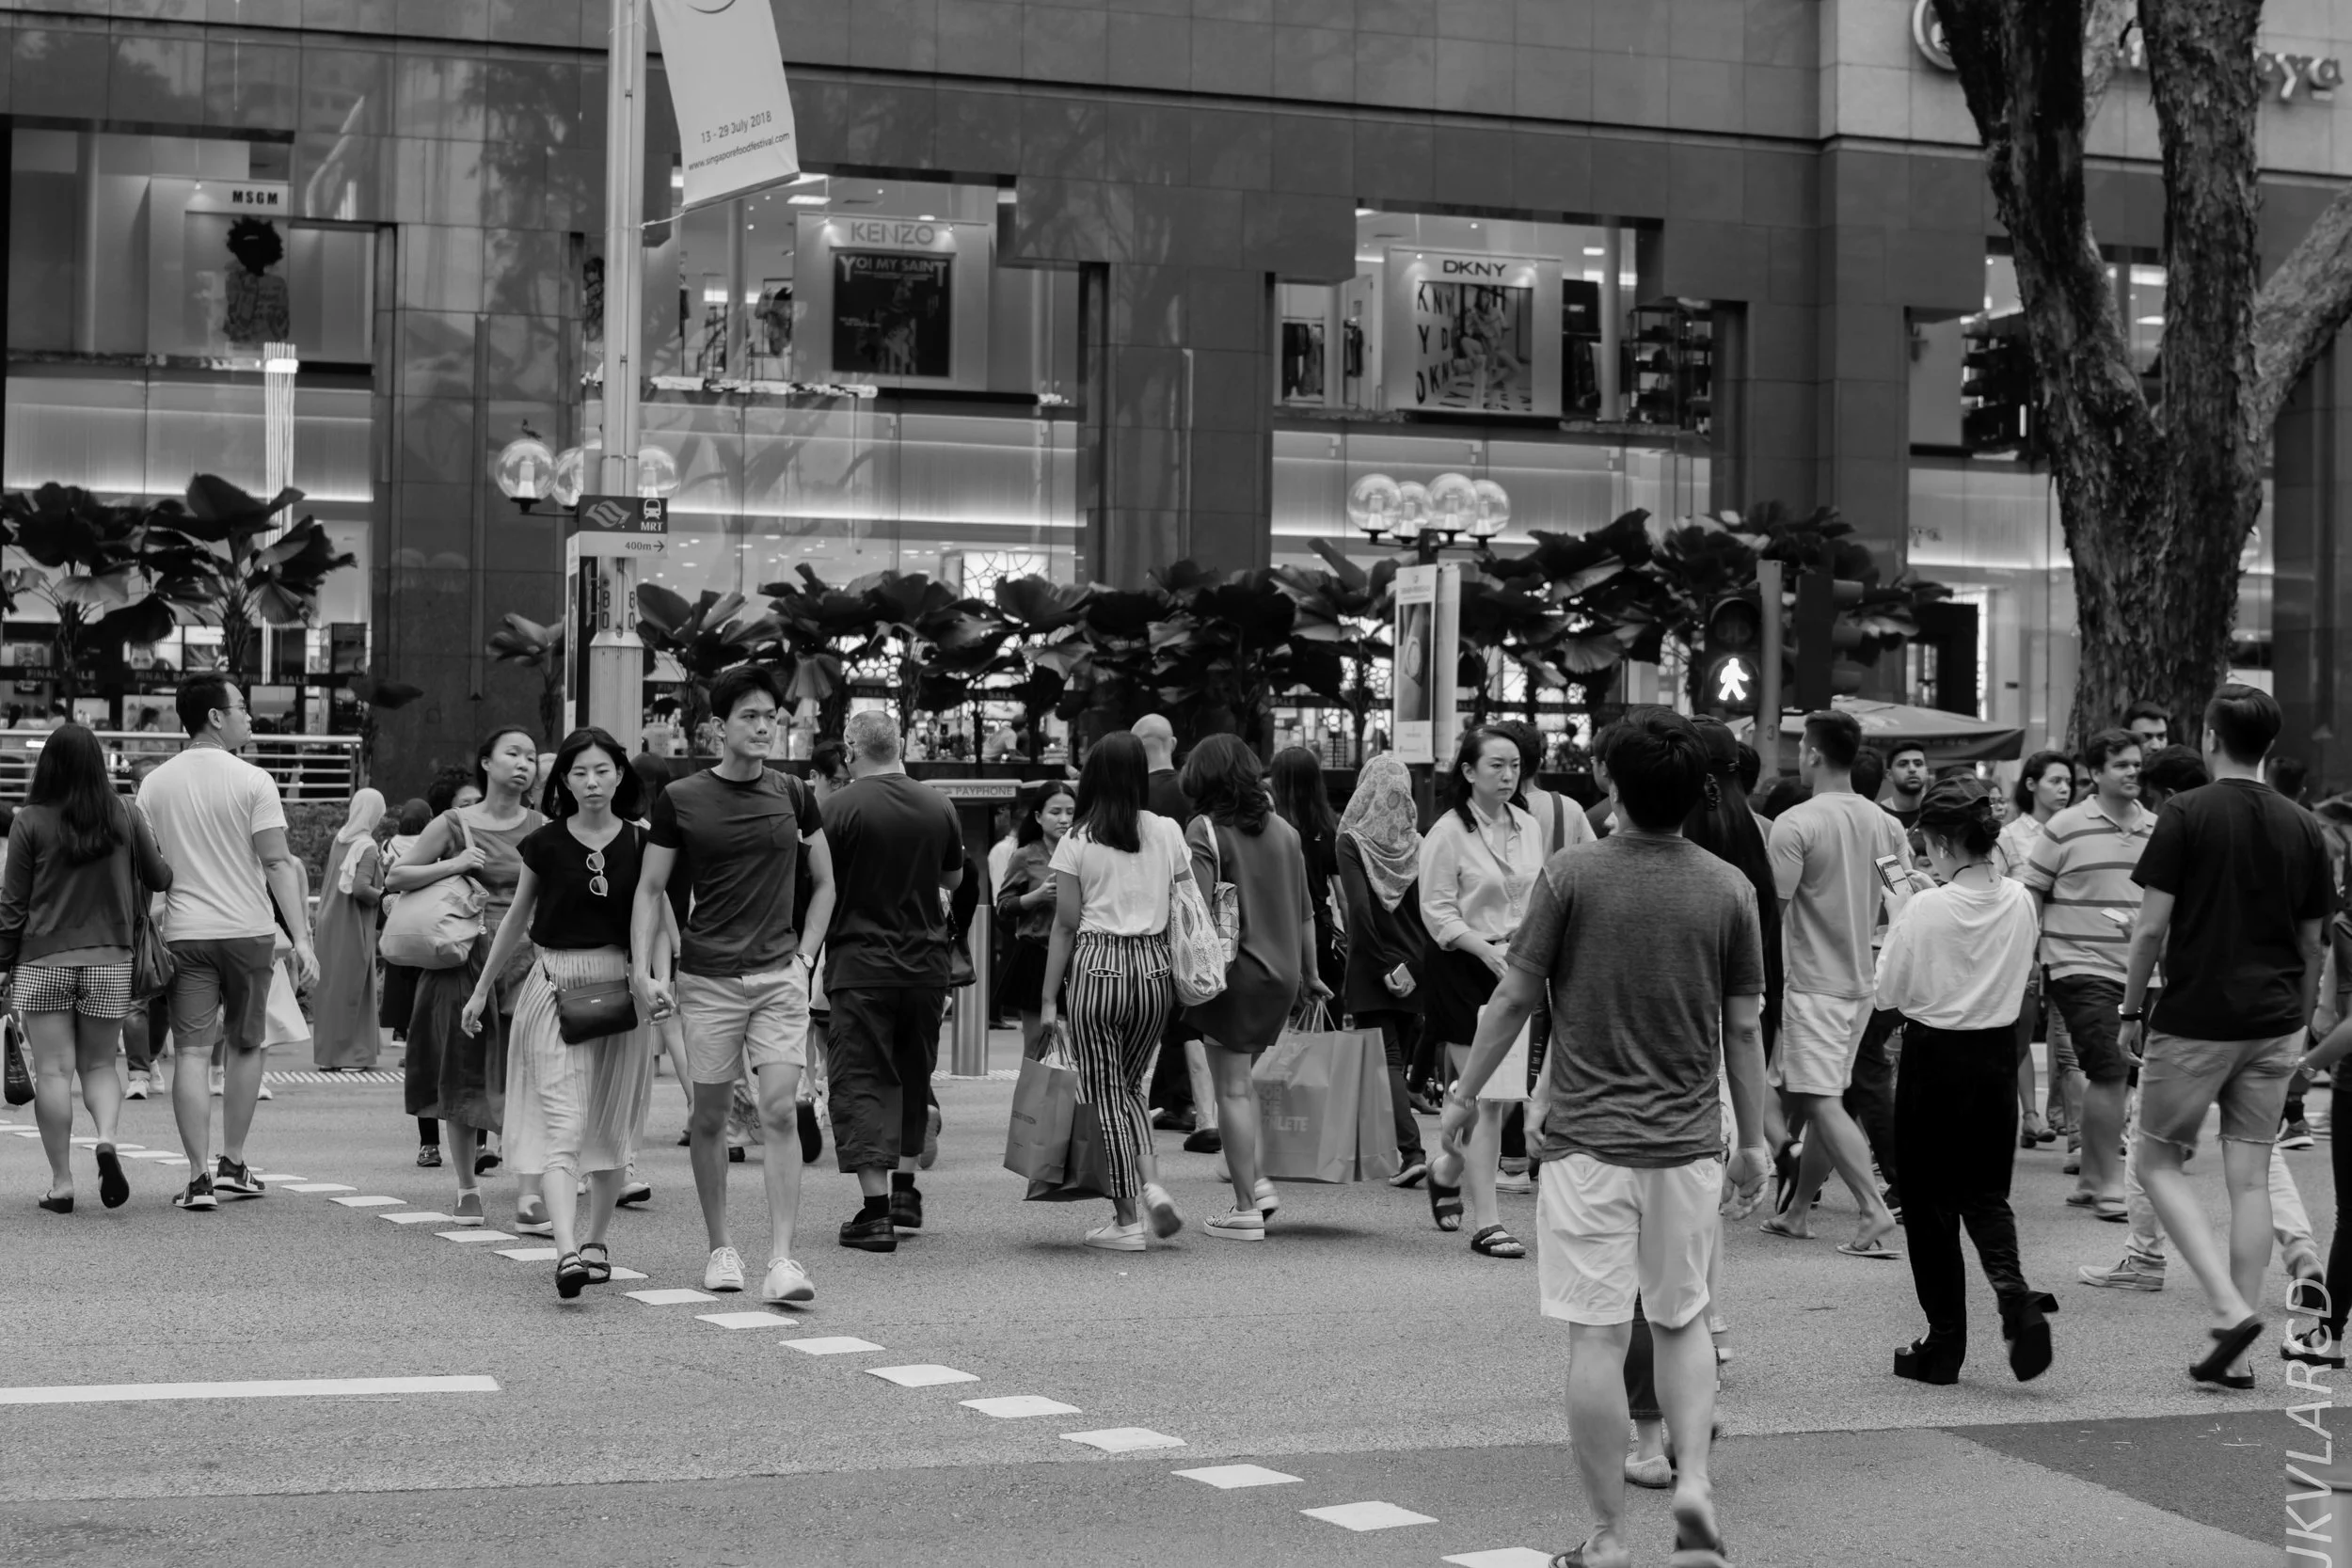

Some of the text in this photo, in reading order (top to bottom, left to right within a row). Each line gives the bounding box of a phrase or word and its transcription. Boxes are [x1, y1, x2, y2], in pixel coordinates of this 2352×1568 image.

[700, 130, 712, 144] 13
[718, 124, 729, 138] 29
[731, 119, 748, 134] July
[751, 110, 772, 128] 2018
[688, 133, 790, 171] www.singaporefoodfestival.com
[231, 190, 278, 205] MSGM
[850, 221, 934, 245] KENZO
[876, 258, 898, 271] MY
[900, 259, 947, 288] SAINT
[1442, 260, 1507, 277] DKNY
[640, 520, 663, 532] MRT
[624, 541, 652, 551] 400m
[955, 785, 1013, 796] PAYPHONE
